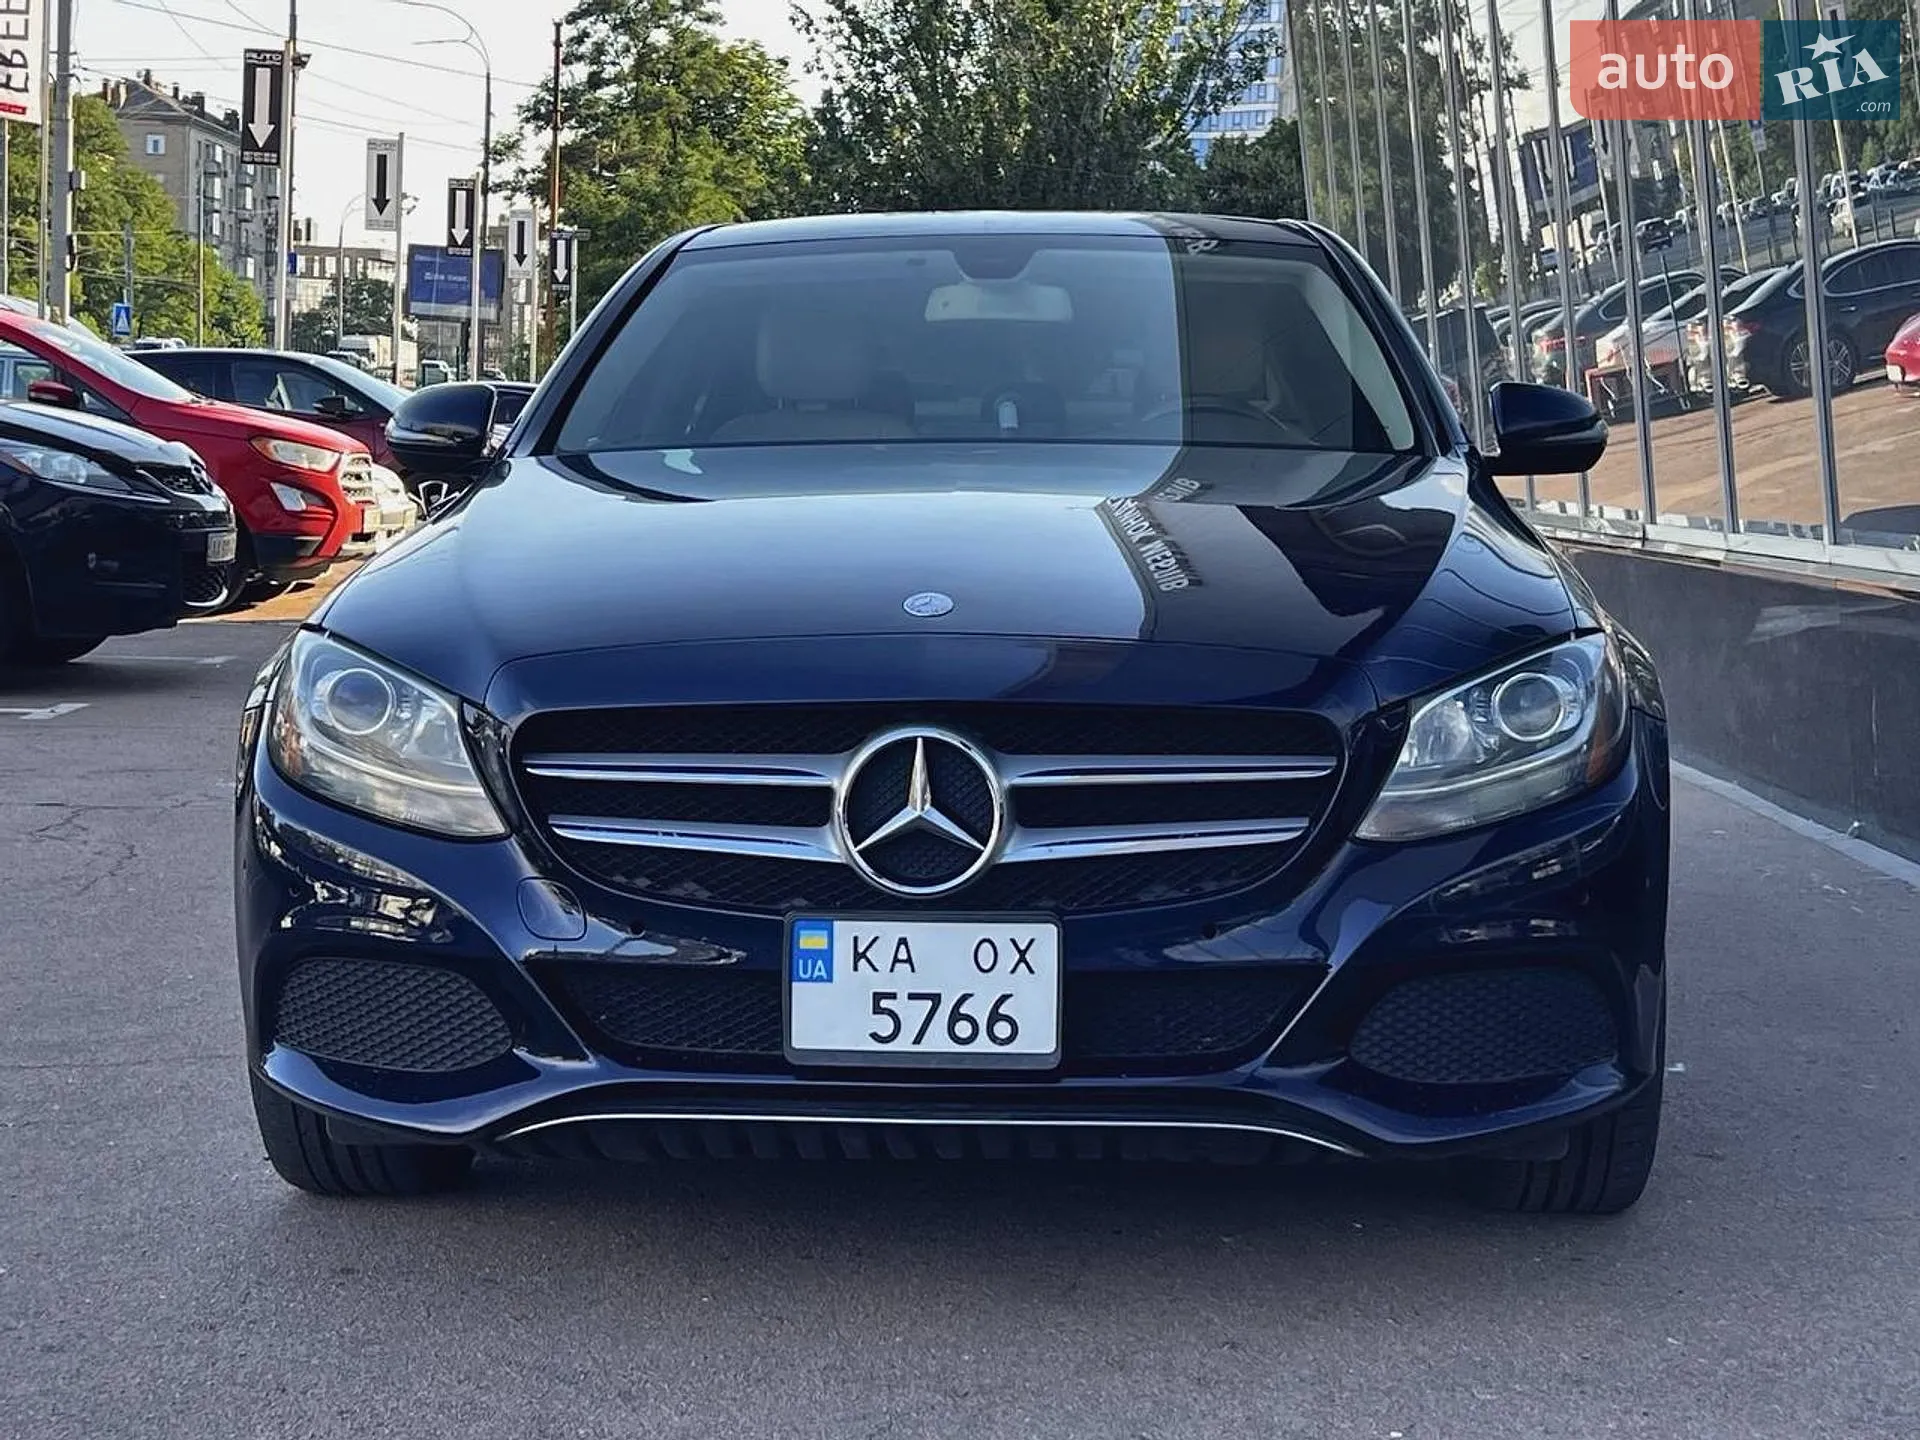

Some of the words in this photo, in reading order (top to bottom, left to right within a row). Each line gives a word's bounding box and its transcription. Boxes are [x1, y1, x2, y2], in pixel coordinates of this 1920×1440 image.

[798, 959, 828, 980] UA
[852, 935, 916, 974] KA
[973, 937, 1036, 975] OX
[869, 991, 1020, 1047] 5766
